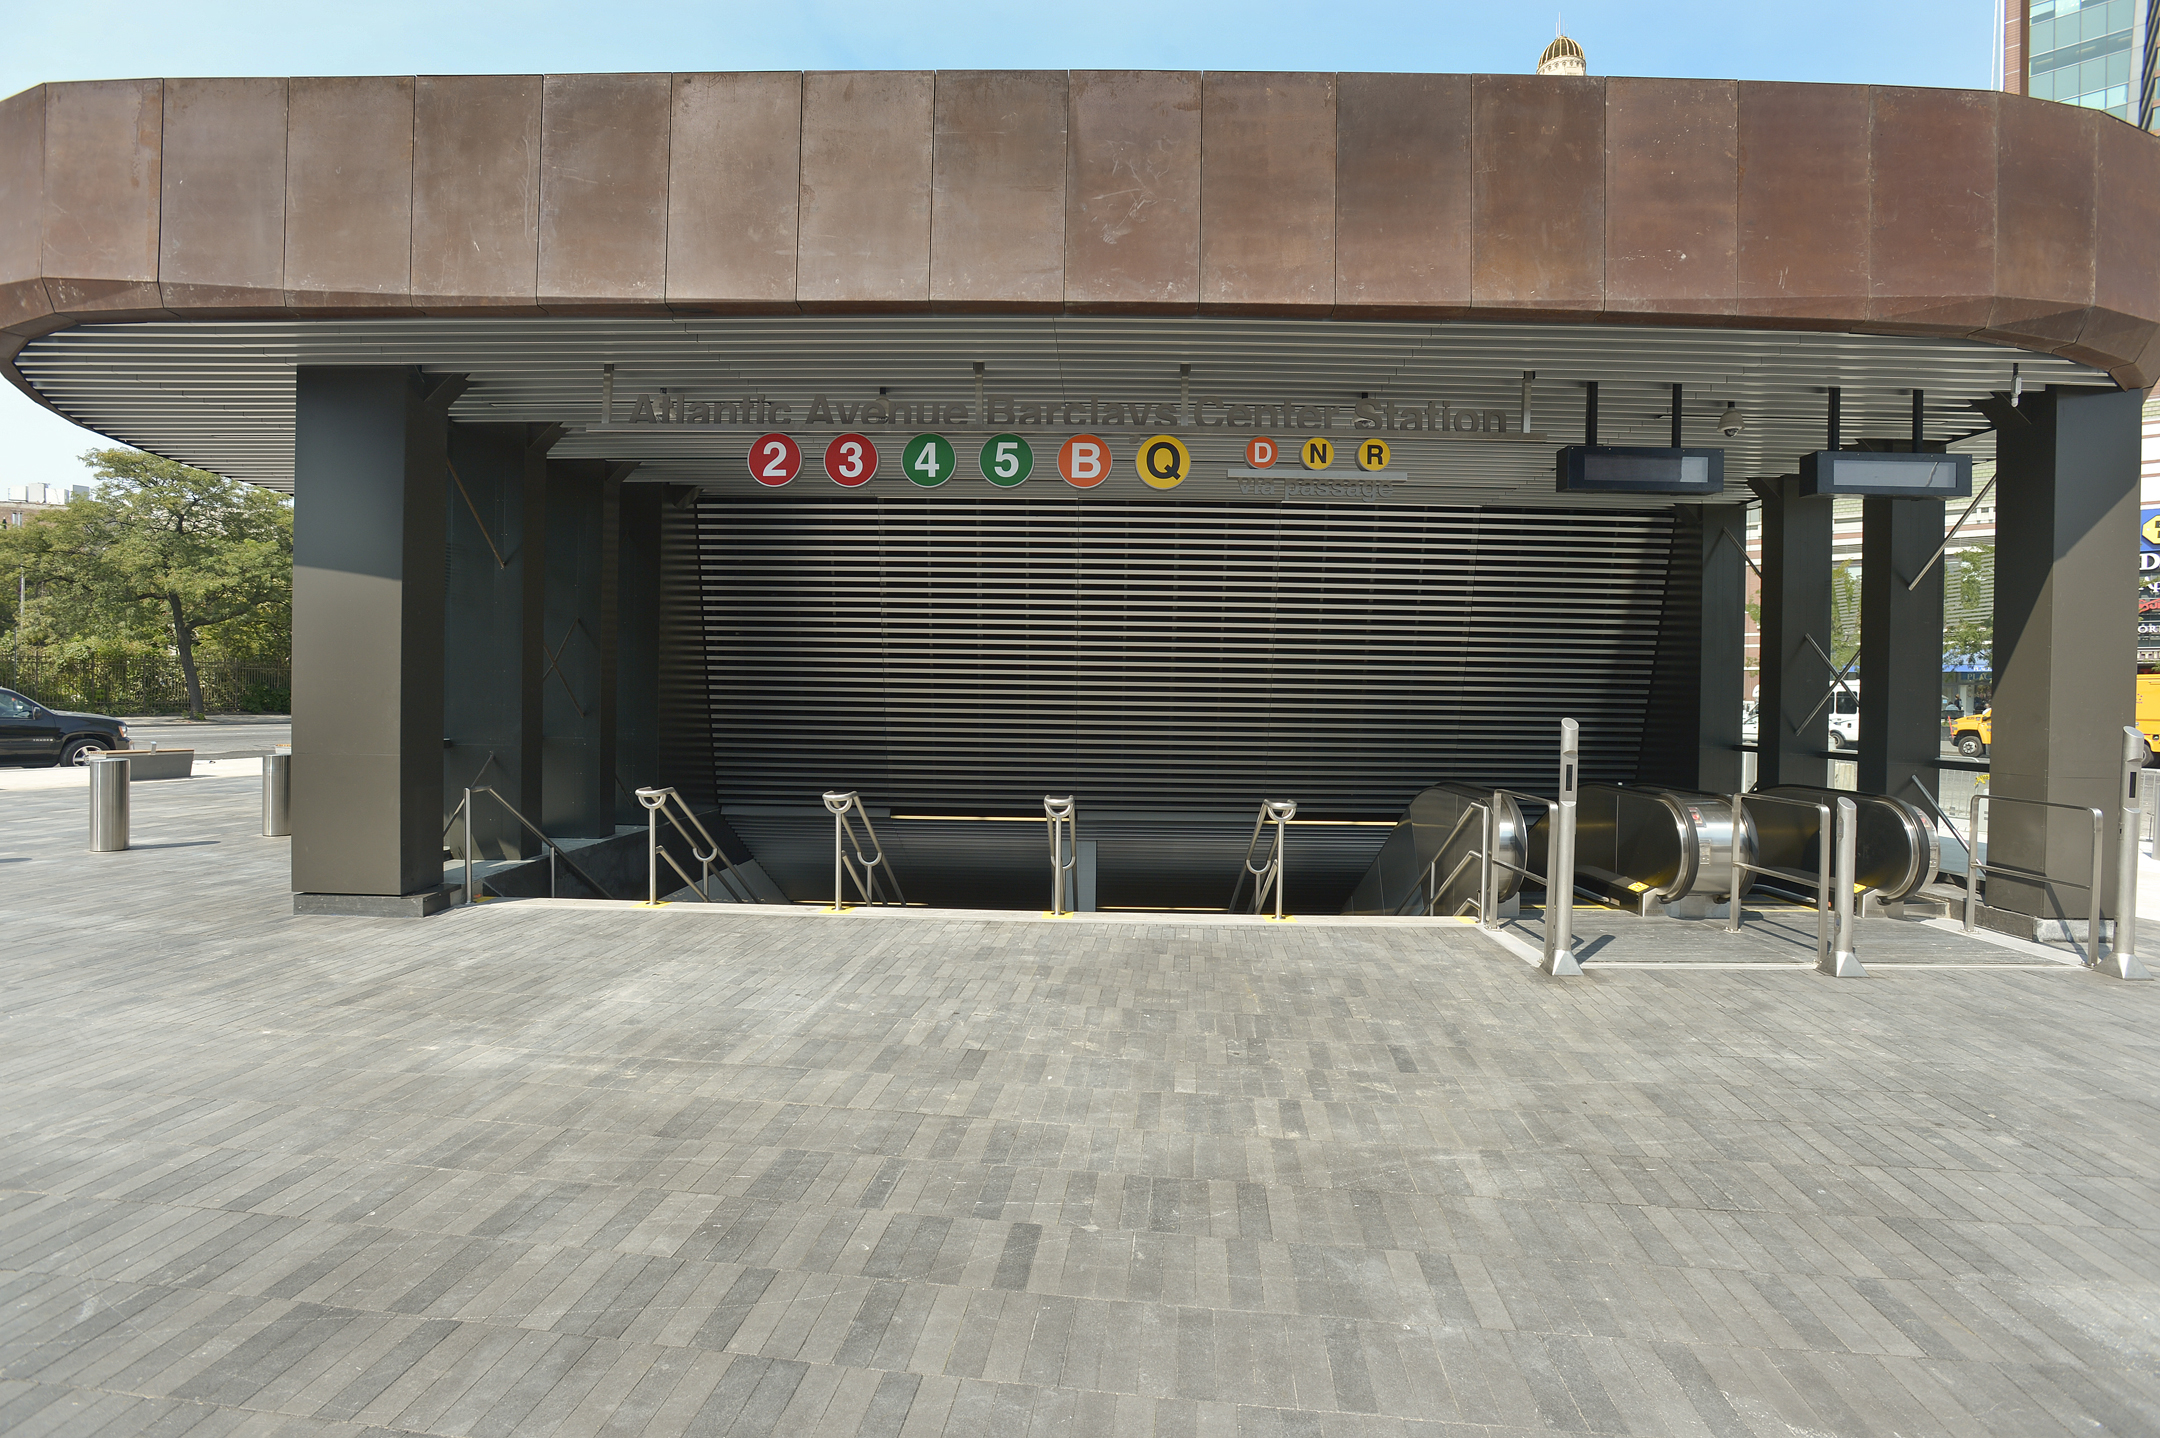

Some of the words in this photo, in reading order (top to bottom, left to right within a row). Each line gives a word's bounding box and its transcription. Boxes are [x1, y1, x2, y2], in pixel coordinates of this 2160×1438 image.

[628, 393, 792, 425] Atlantic
[805, 393, 969, 425] Avenue
[987, 394, 1178, 444] Barclays
[1194, 396, 1340, 429] Center
[1354, 400, 1507, 433] Station
[762, 441, 787, 477] 2
[838, 441, 864, 478] 3
[914, 442, 940, 478] 4
[993, 442, 1020, 478] 5
[1071, 442, 1101, 479] B
[1146, 442, 1181, 480] Q
[1254, 443, 1273, 464] D
[1309, 443, 1327, 464] N
[1366, 444, 1384, 465] R
[1237, 477, 1276, 496] via
[1284, 478, 1394, 503] passage
